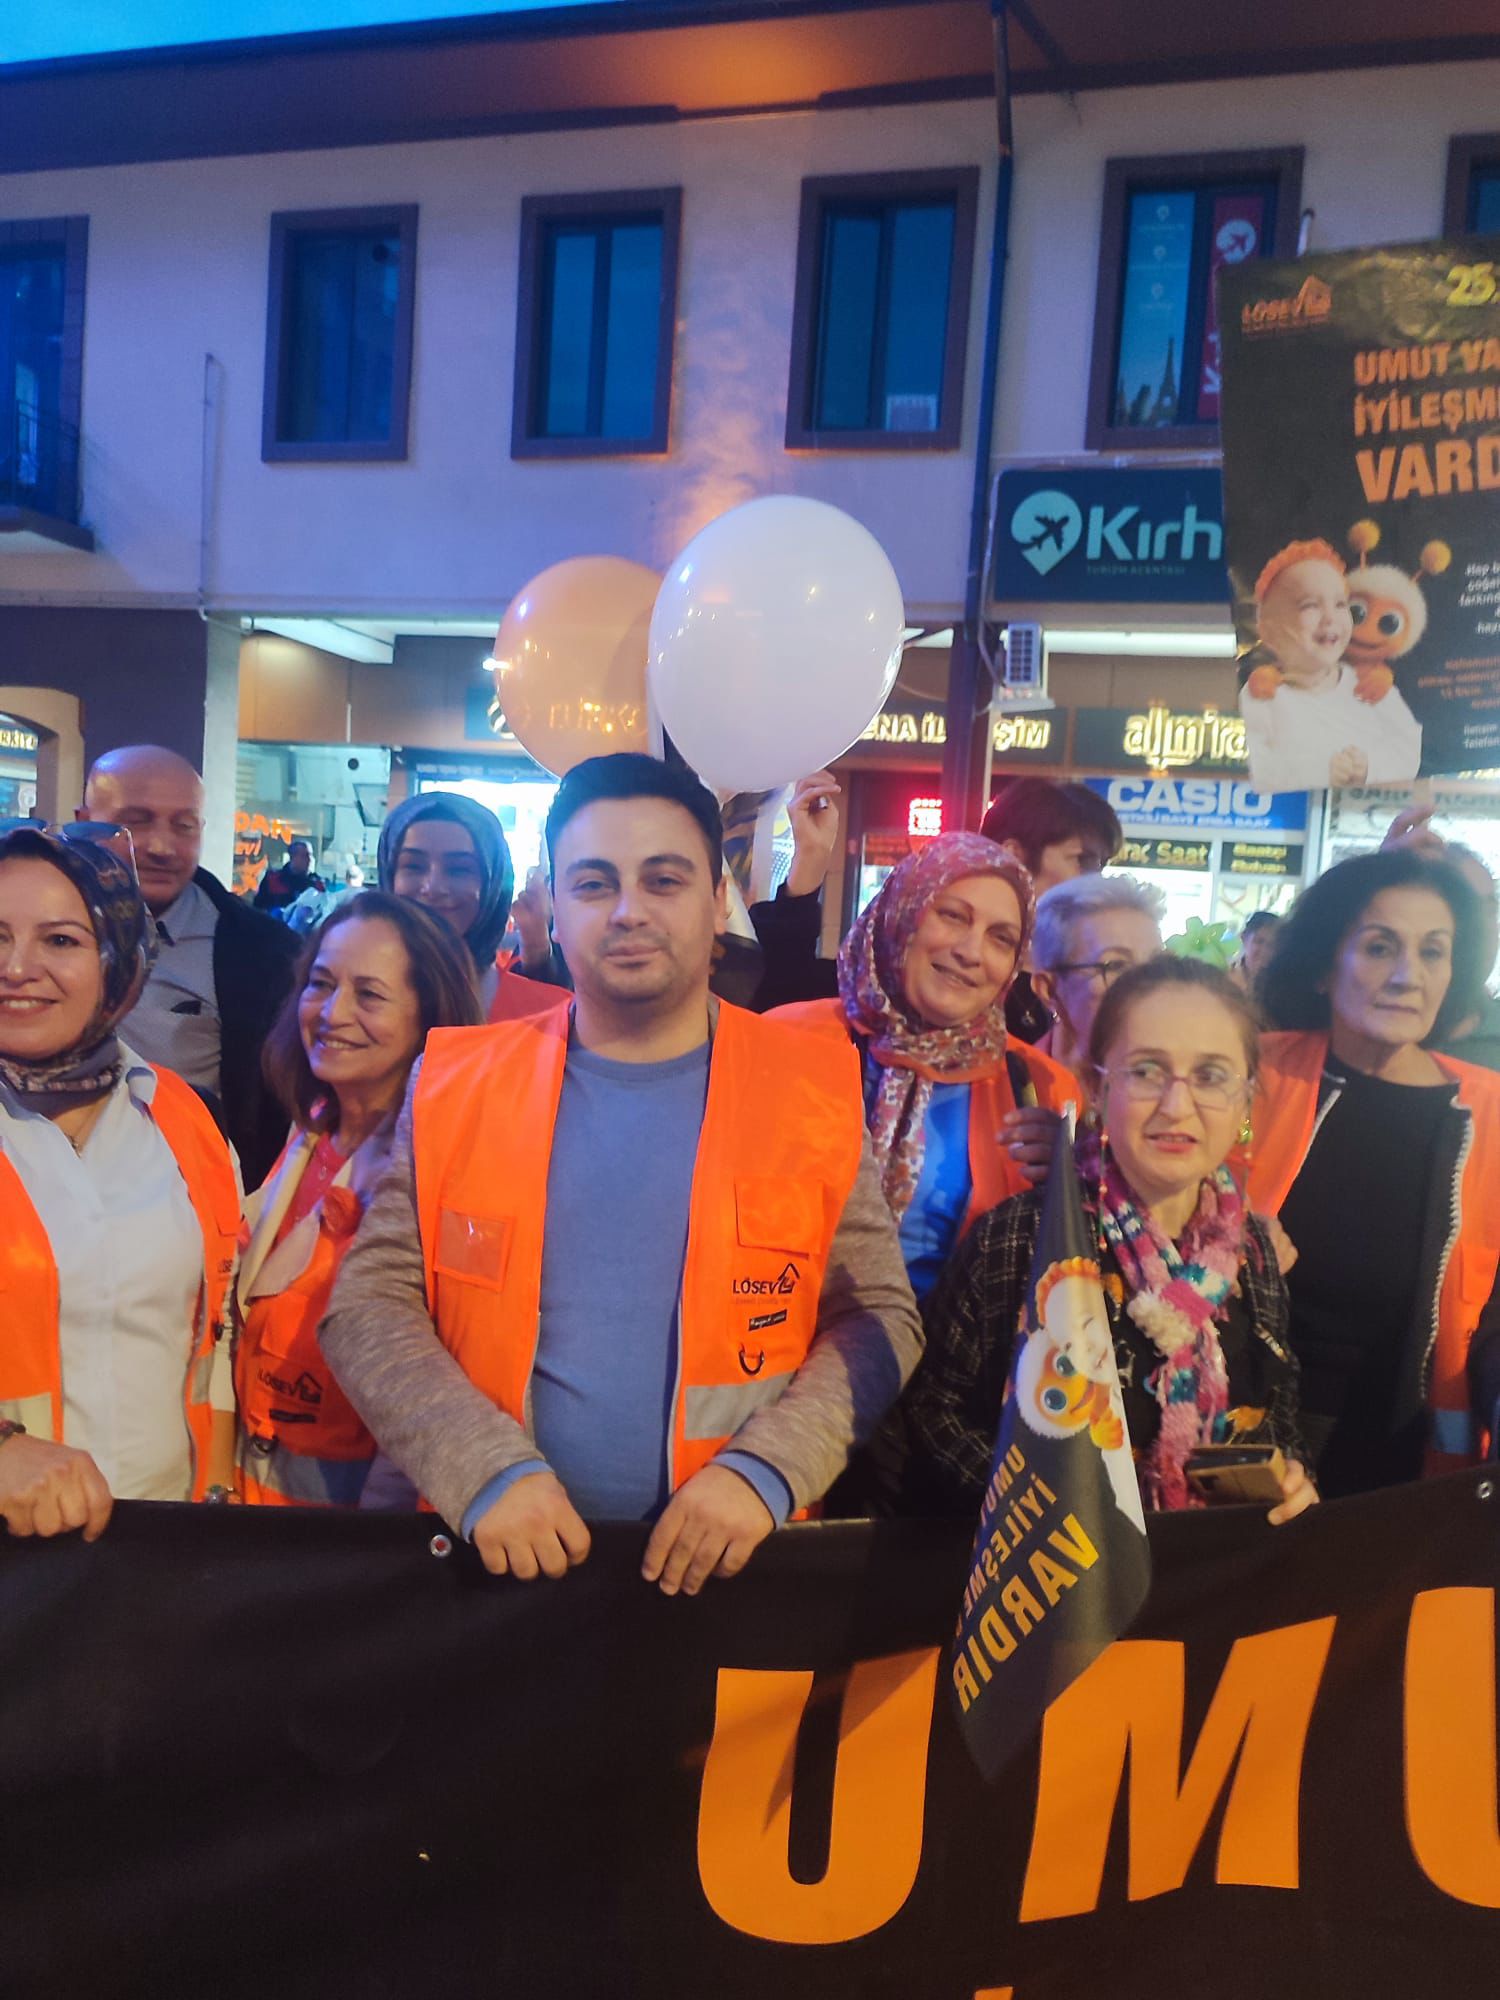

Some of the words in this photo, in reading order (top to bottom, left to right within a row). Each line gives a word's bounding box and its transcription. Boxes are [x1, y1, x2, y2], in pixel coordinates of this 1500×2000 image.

[1354, 343, 1450, 386] UMUT
[1354, 384, 1500, 437] İYİLEŞM
[1107, 778, 1273, 817] CASIO
[1157, 840, 1209, 866] Saat
[732, 1276, 782, 1295] LÖSEV
